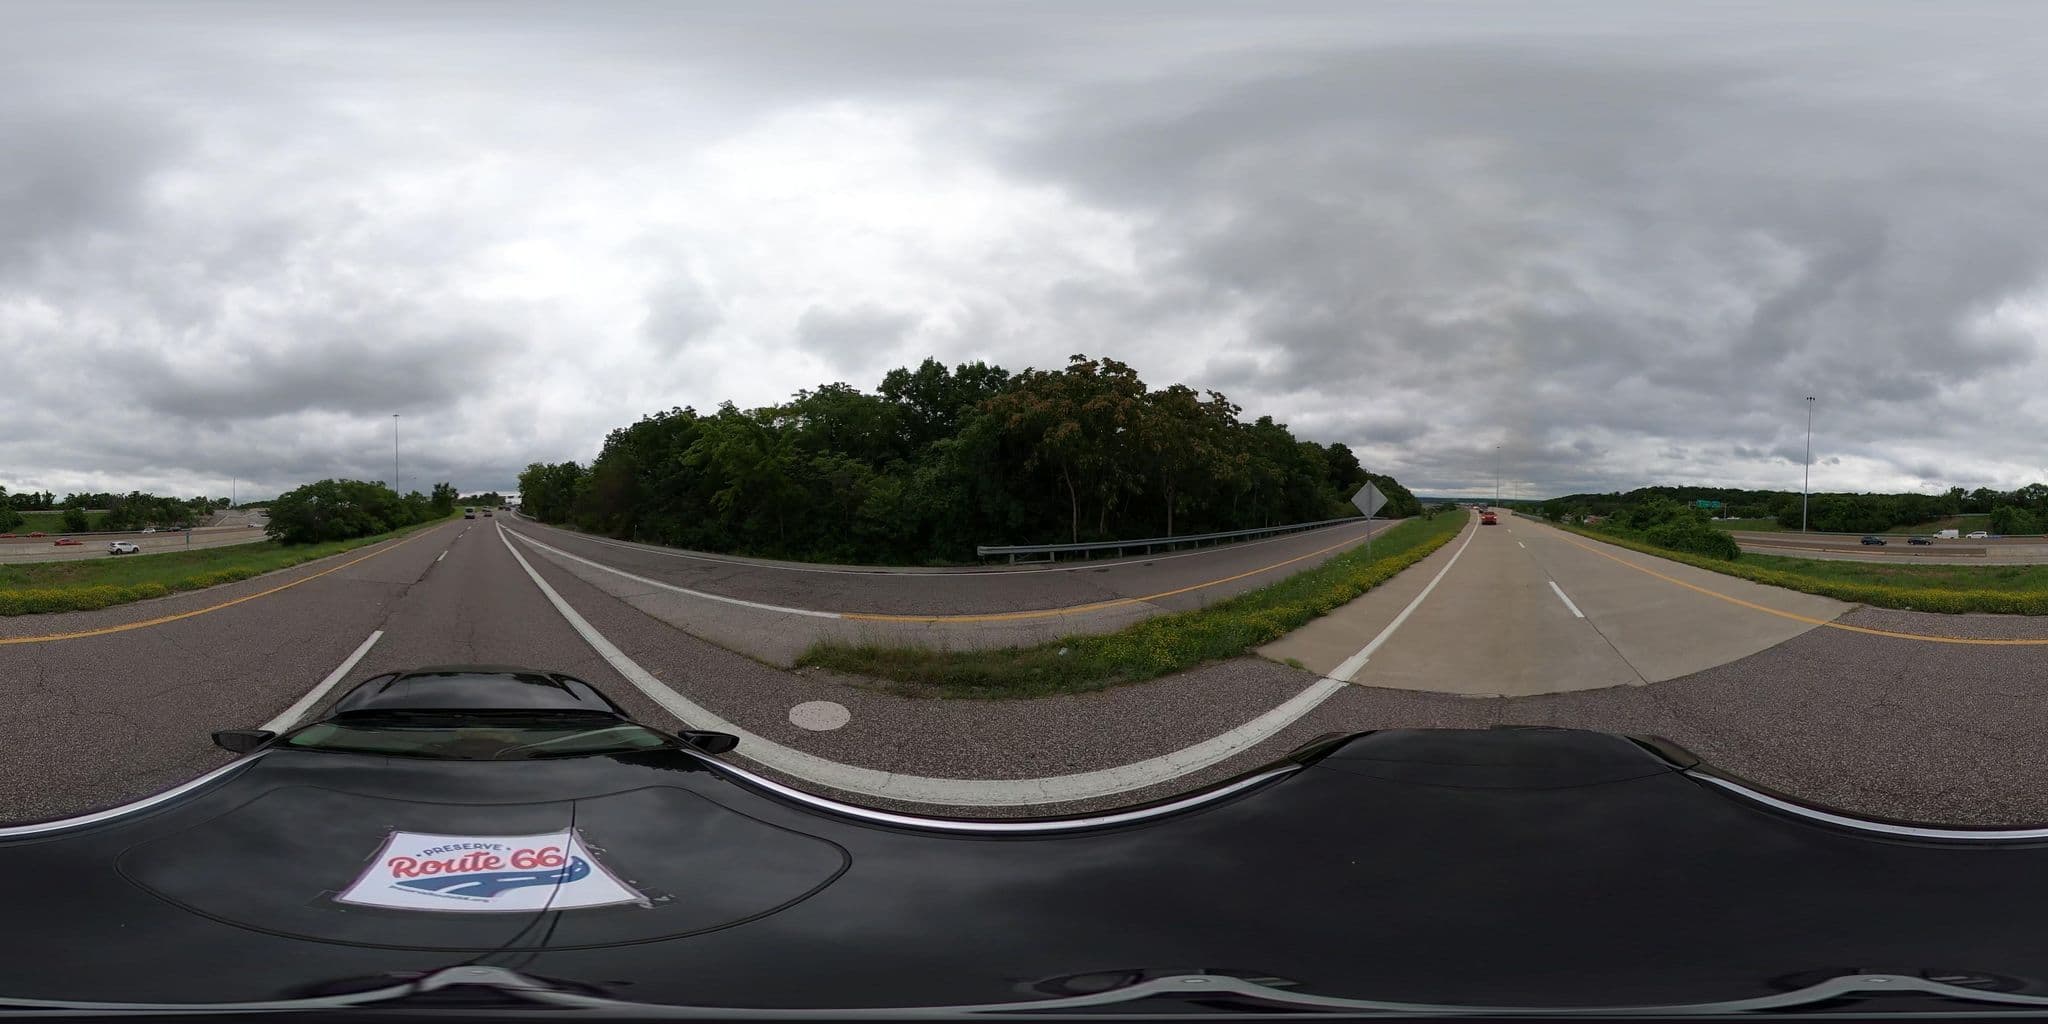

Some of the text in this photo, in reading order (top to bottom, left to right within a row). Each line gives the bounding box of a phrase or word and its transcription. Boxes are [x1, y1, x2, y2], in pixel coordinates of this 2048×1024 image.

[423, 843, 503, 856] PRESERVE
[388, 846, 564, 878] Route 66
